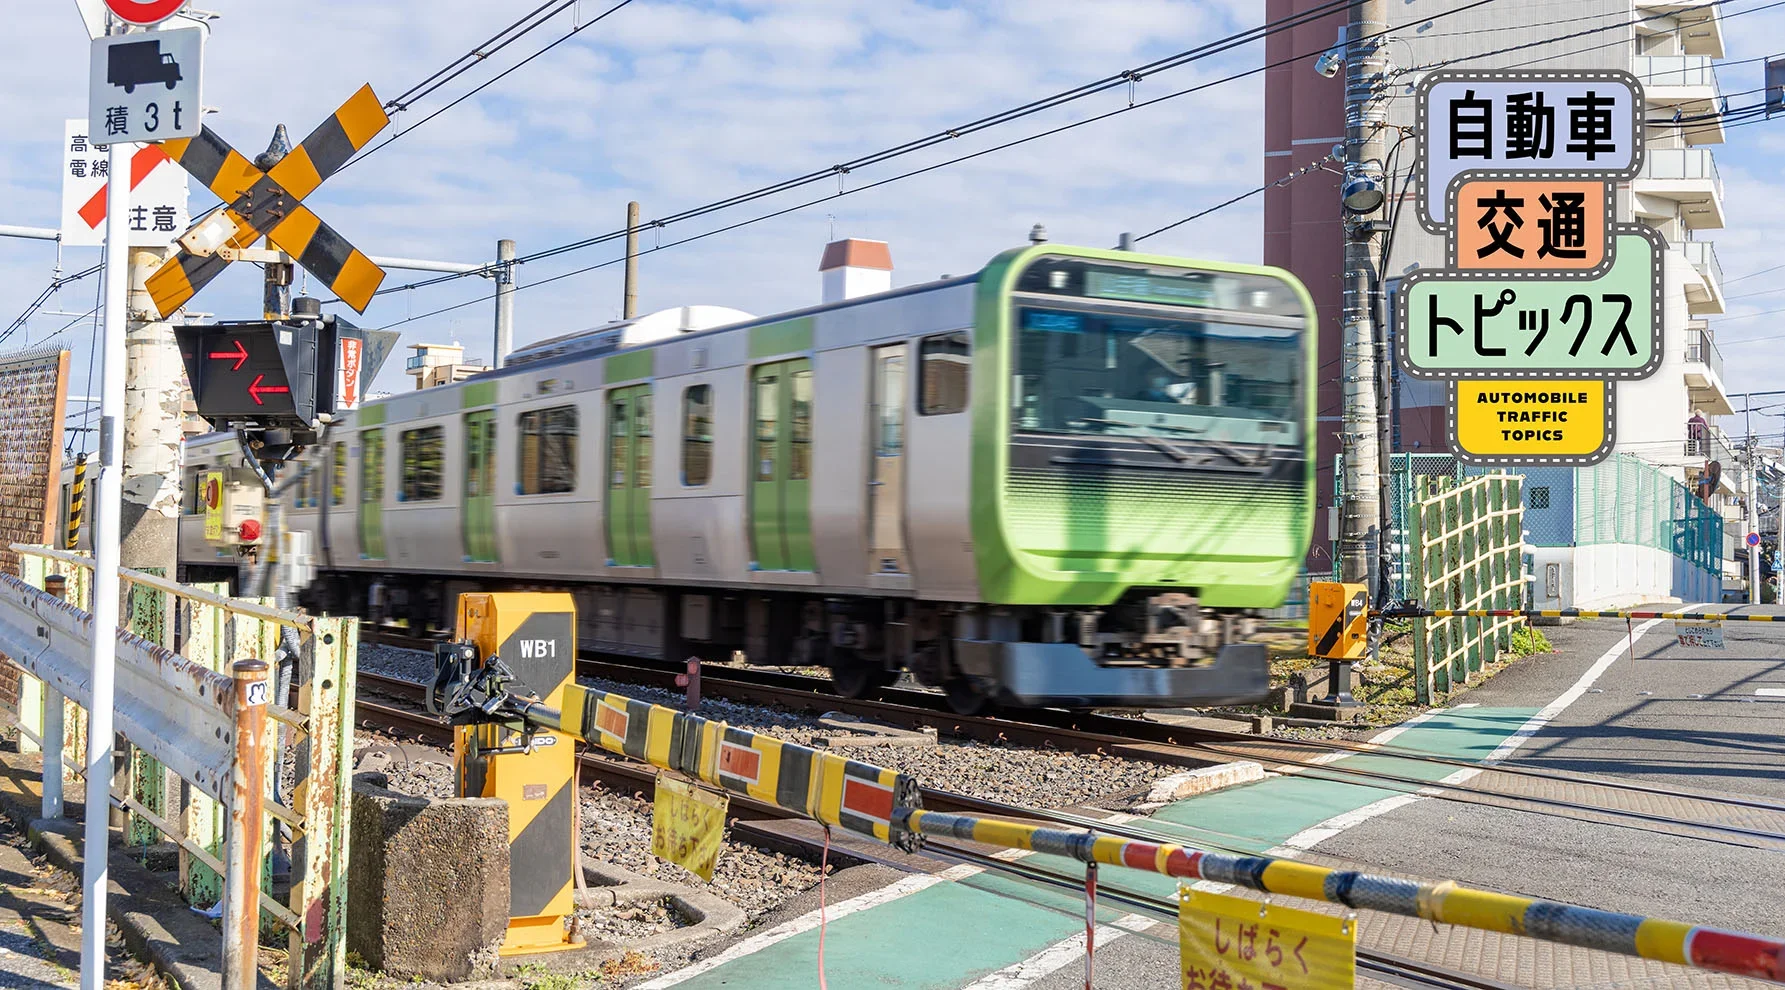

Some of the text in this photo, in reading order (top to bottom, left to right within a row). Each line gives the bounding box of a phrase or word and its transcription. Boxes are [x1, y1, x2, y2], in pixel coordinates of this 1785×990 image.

[346, 340, 357, 387] 非常ボタン
[520, 639, 556, 658] WB1
[1215, 917, 1309, 975] しばらく
